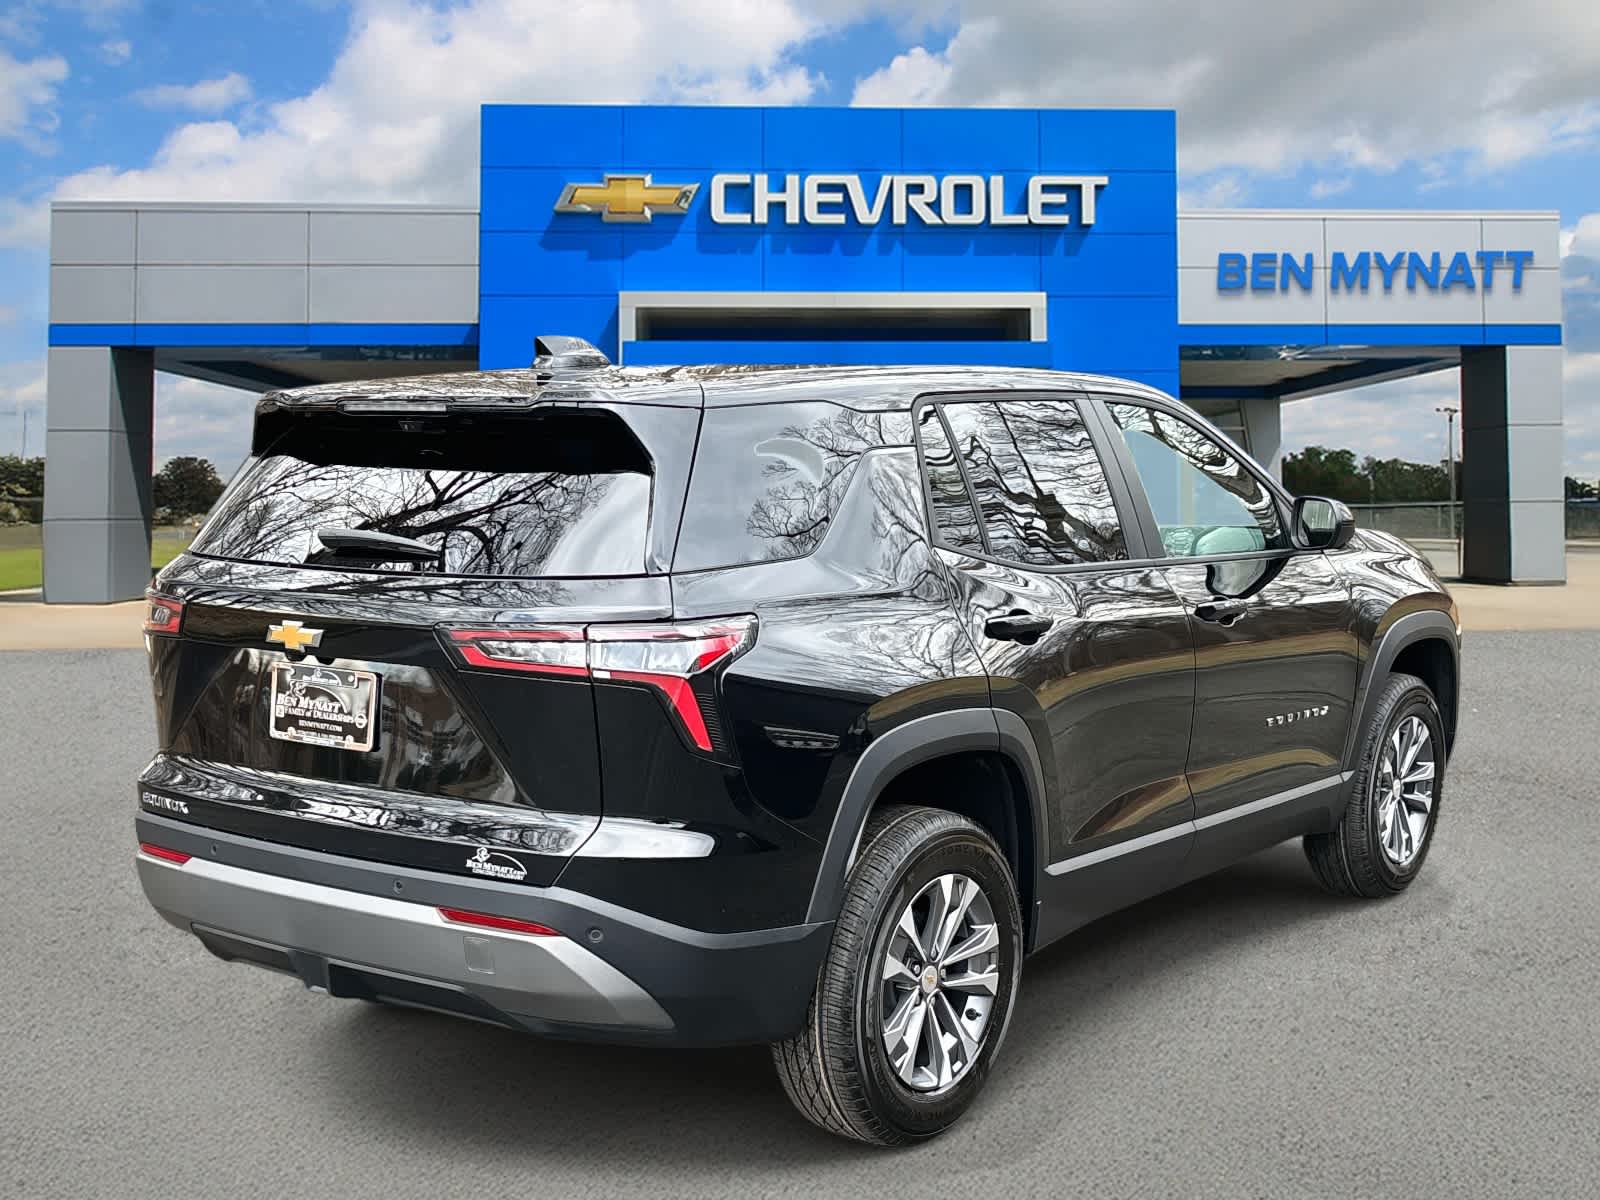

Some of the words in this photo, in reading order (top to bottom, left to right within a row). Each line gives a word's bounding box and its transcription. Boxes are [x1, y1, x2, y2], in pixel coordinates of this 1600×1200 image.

[710, 173, 1109, 225] CHEVROLET
[1217, 252, 1313, 290] BEN
[1330, 250, 1534, 290] MYNATT
[277, 692, 297, 707] BEN
[298, 696, 341, 713] MYNATT
